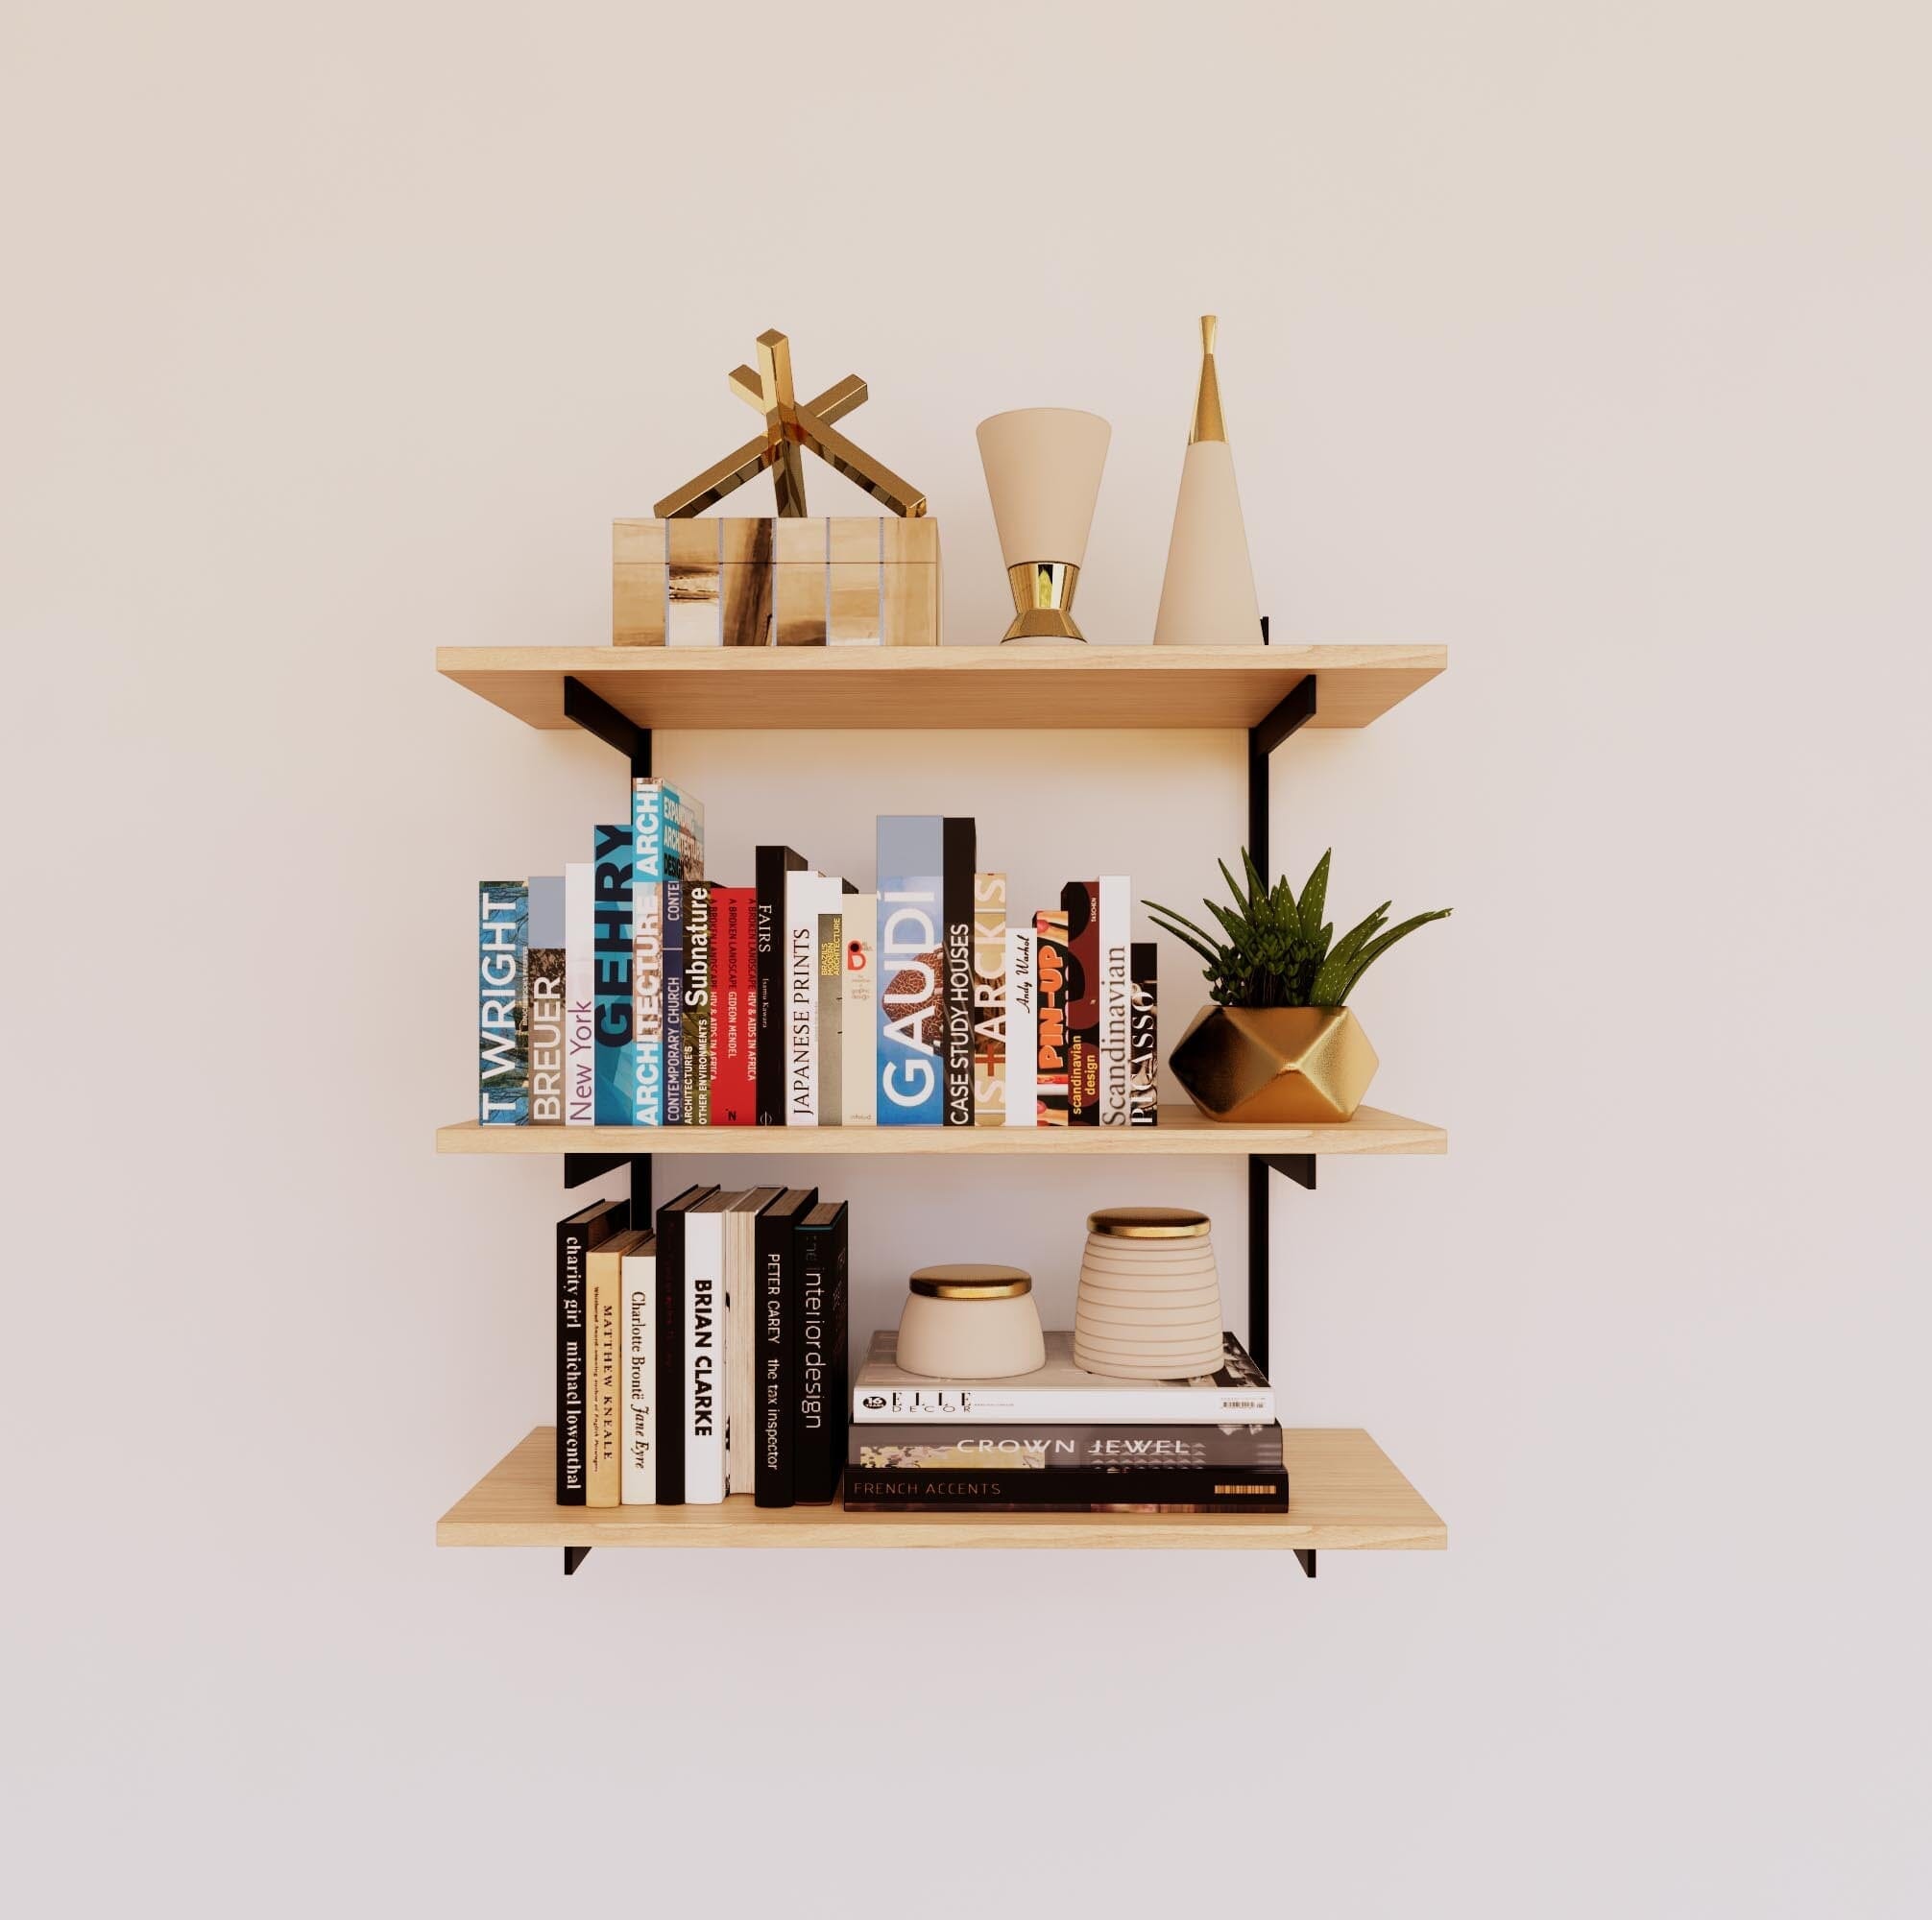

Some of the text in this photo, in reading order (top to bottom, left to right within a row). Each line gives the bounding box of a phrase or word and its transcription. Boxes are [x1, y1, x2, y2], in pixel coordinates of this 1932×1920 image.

[594, 826, 633, 1046] GEHRY
[684, 887, 707, 1007] Subnature
[728, 906, 737, 940] BROKEN
[748, 906, 757, 940] BROKEN
[759, 904, 772, 953] FAIRS
[482, 893, 516, 1080] WRIGHT
[667, 977, 680, 1024] CHURCH
[728, 942, 737, 989] LANDSCAPE
[747, 991, 757, 1006] HIV
[748, 942, 757, 989] LANDSCAPE
[1016, 934, 1033, 1014] Andy Warhol
[636, 894, 660, 1126] ARCHITECTURE
[728, 991, 737, 1023] GIDEON
[728, 1024, 737, 1059] MENDEL
[747, 1017, 757, 1038] AIDS
[747, 1039, 757, 1049] IN
[793, 928, 814, 1115] JAPANESE PRINTS
[951, 924, 969, 1125] CASE STUDY HOUSES
[1038, 945, 1064, 1069] PIN-UP
[1101, 946, 1126, 1126] Scandinavian
[534, 977, 561, 1119] BREUER
[568, 1000, 592, 1119] New York
[667, 1027, 680, 1121] CONTEMPORARY
[698, 1019, 707, 1124] OTHER ENVIRONMENTS
[747, 1051, 757, 1081] AFRICA
[1071, 1035, 1082, 1115] scandinavian
[1084, 1054, 1098, 1095] design
[1131, 991, 1154, 1123] PICASSO
[806, 1267, 826, 1348] interior
[563, 1236, 582, 1489] charity girl michael lowenthal
[603, 1305, 613, 1460] MATTHEW KNEALE
[631, 1291, 650, 1469] Charlotte Brontë Jane Eyre
[694, 1280, 712, 1436] BRIAN CLARKE
[764, 1254, 781, 1471] PETER CAREY the tax inspector
[801, 1353, 826, 1428] design
[892, 1392, 972, 1405] ELLE
[956, 1439, 1190, 1453] CROWN JEWEL
[854, 1482, 1002, 1495] FRENCH ACCENTS
